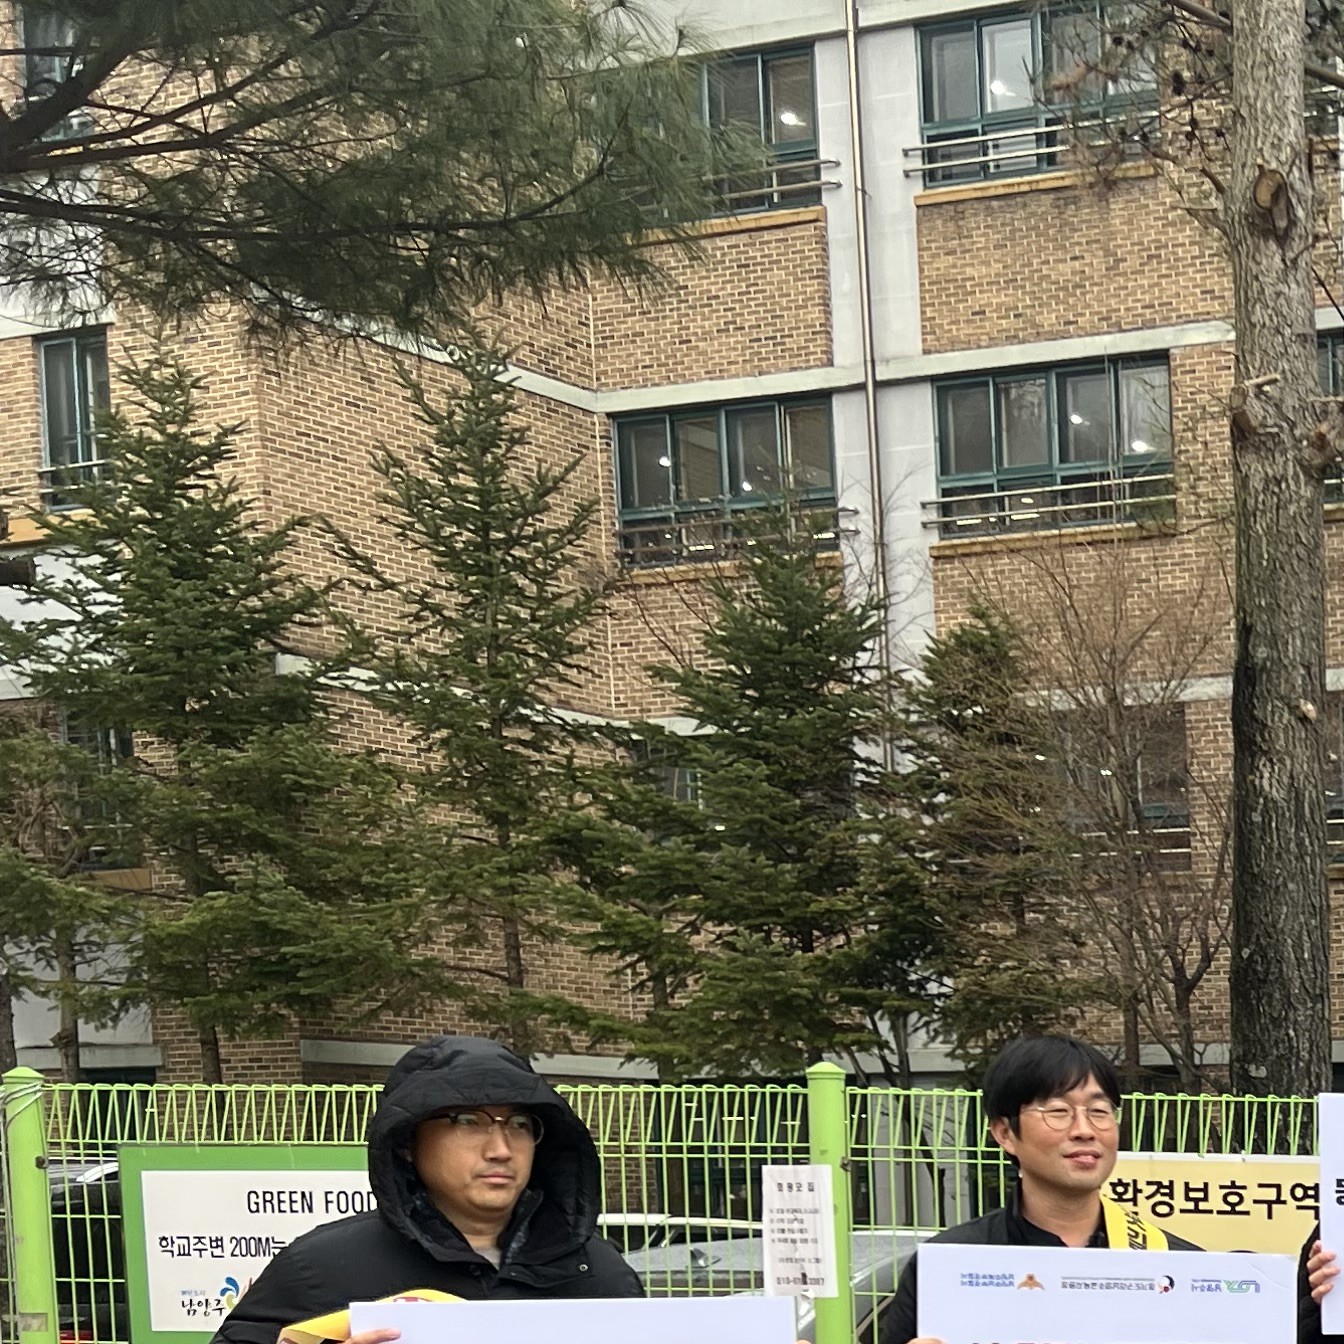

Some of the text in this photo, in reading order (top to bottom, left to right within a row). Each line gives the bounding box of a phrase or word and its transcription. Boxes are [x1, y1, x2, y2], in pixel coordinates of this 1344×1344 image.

[247, 1190, 314, 1214] GREEN
[158, 1236, 225, 1259] 학교주변
[181, 1298, 227, 1317] 남양주
